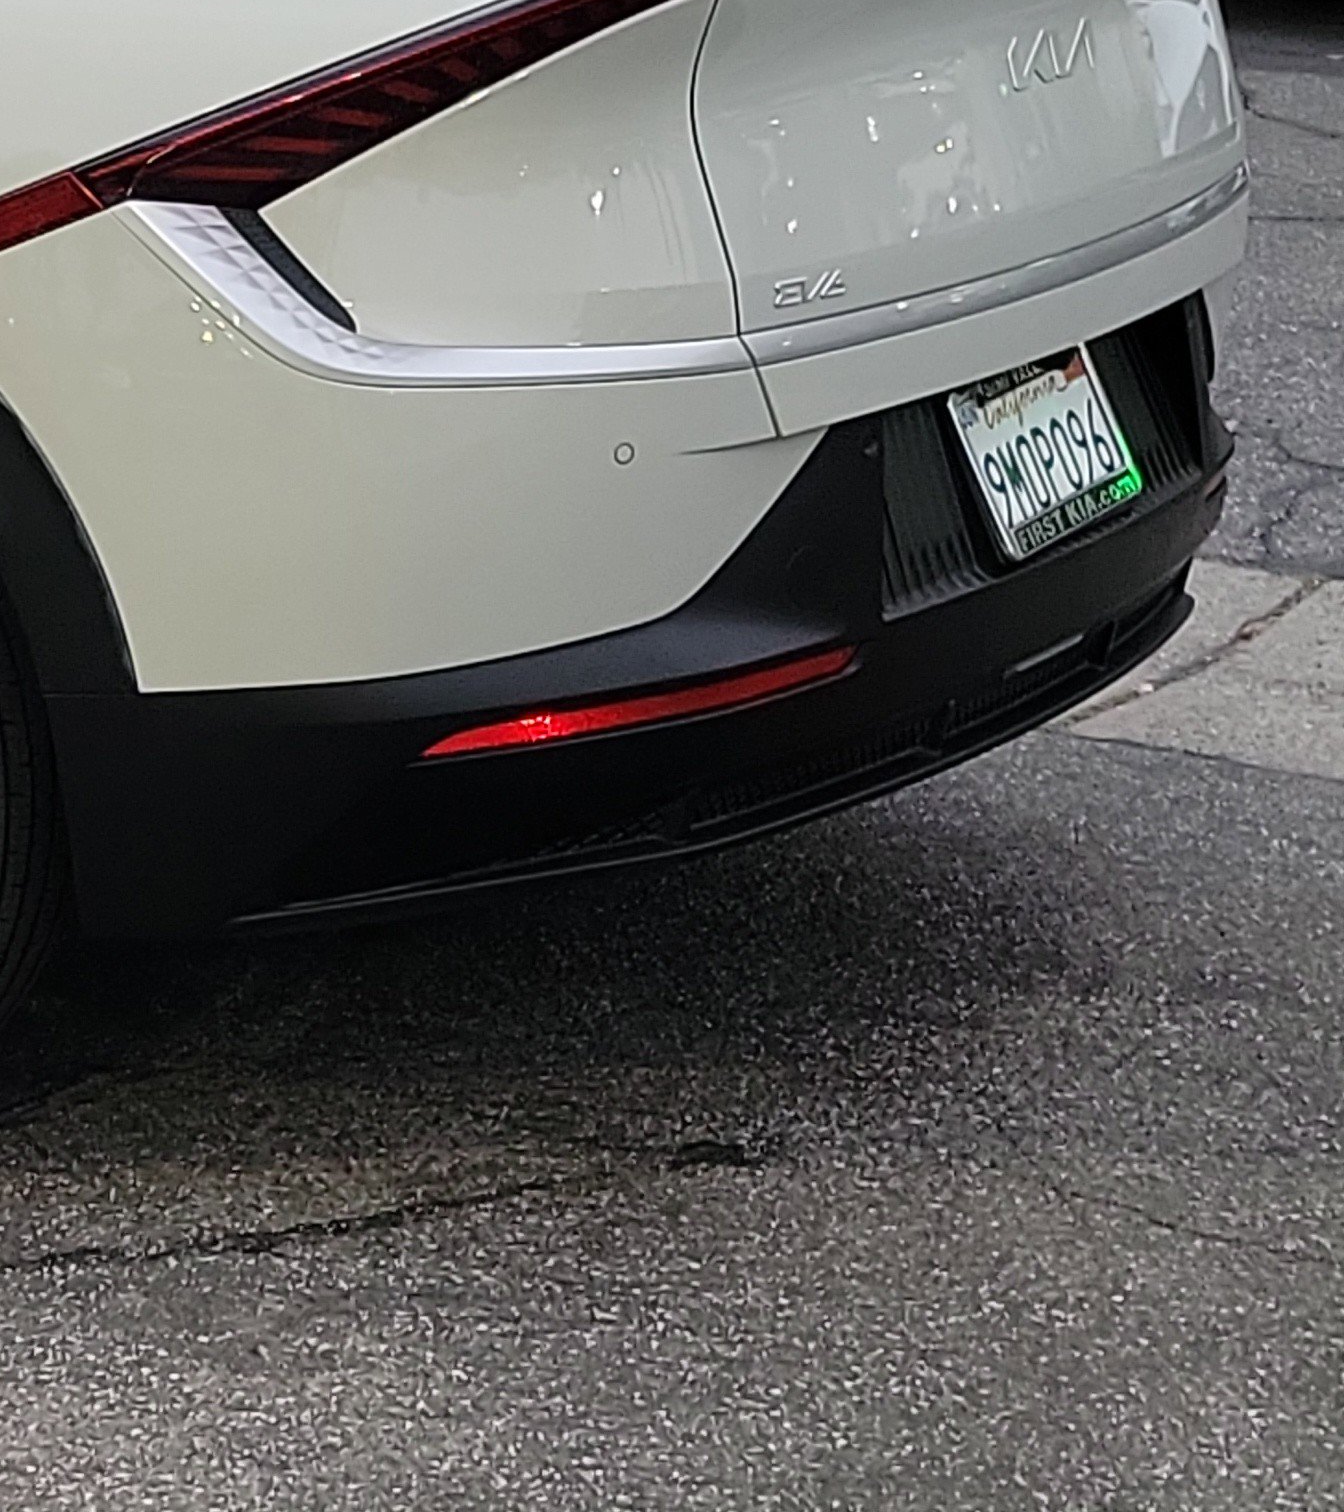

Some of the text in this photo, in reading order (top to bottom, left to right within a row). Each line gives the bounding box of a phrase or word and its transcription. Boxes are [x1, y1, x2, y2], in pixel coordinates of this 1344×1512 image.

[1007, 17, 1095, 91] KIA
[774, 269, 846, 307] EV6
[983, 373, 1068, 429] California
[1018, 474, 1137, 552] FIRST KIA.com
